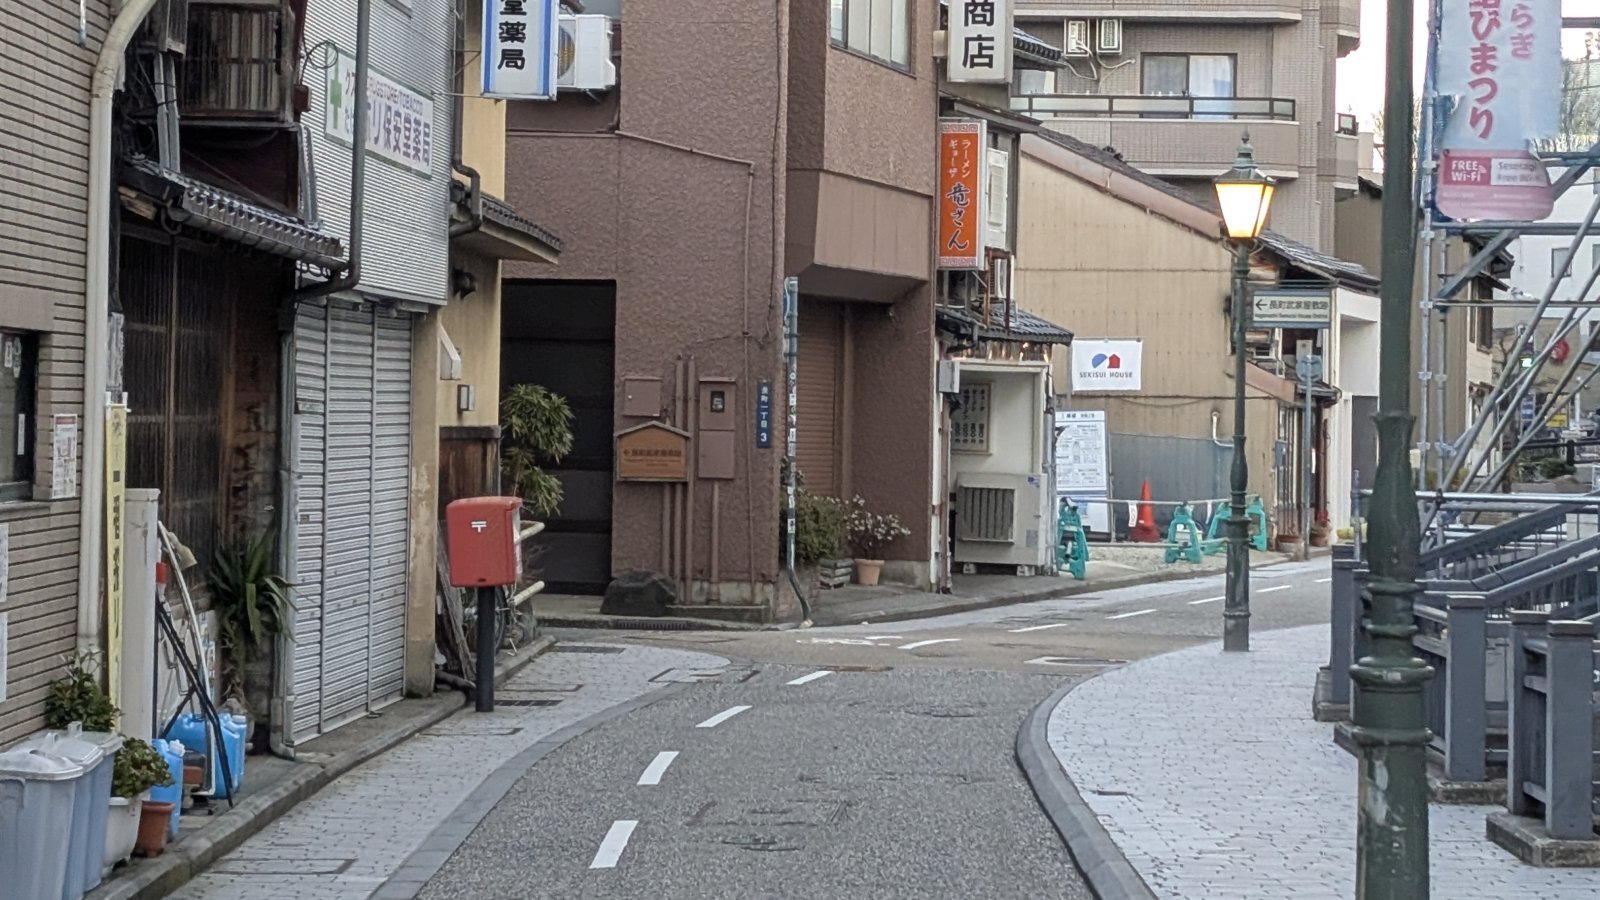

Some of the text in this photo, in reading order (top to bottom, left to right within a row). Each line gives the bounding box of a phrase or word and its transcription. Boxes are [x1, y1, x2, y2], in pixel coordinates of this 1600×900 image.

[962, 0, 995, 69] 商店
[1467, 0, 1501, 140] びまつり
[961, 139, 972, 179] ラーメン
[1451, 160, 1479, 171] FREE
[1451, 171, 1481, 182] Wi-Fi
[760, 432, 767, 442] 3
